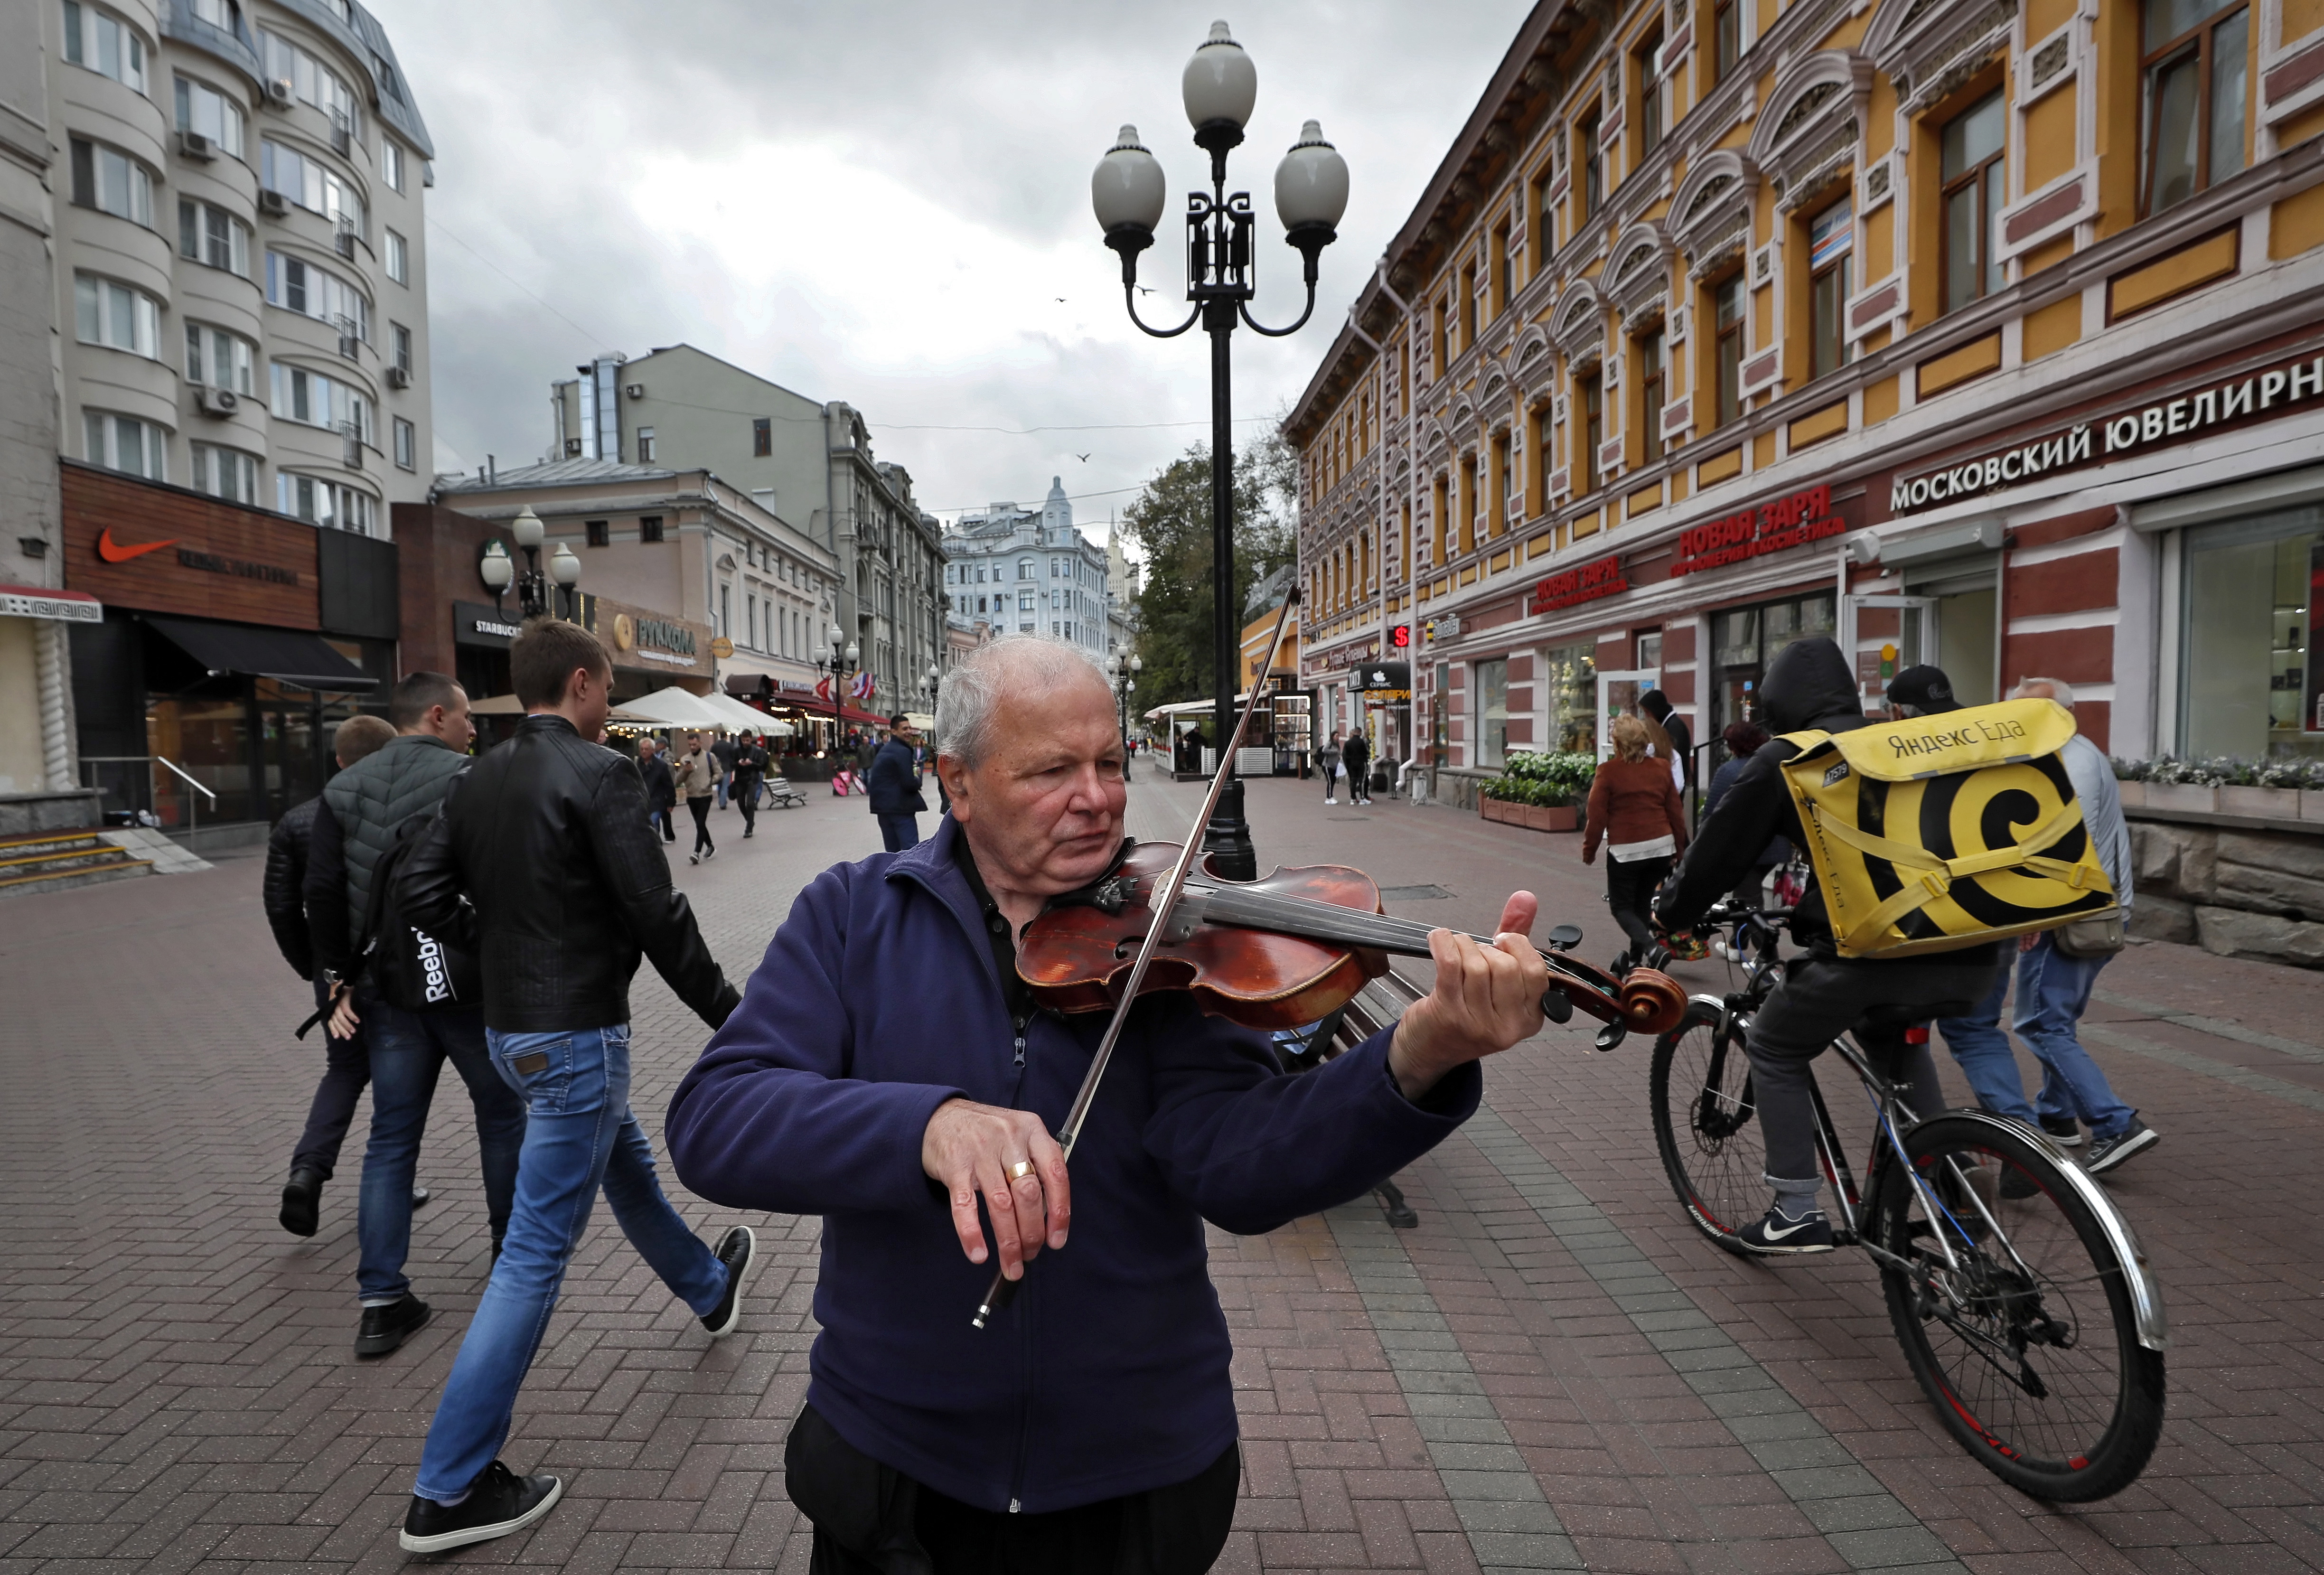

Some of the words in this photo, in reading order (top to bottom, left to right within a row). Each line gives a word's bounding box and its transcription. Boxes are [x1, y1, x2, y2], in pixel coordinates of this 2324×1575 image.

[1890, 424, 2091, 512] МОСКОВСКИЙ
[2105, 356, 2324, 453] ЮВЕЛИРН
[1680, 510, 1755, 557] НОВАЯ
[1760, 484, 1831, 533] ЗАРЯ
[1670, 545, 1745, 577] ПАРФЮМЕРИЯ
[1760, 516, 1846, 551] КОСМЕТИКА
[1537, 569, 1578, 601] НОВАЯ
[1580, 555, 1619, 588] ЗАРЯ
[638, 618, 696, 656] РУККОЛА
[1395, 626, 1409, 647] $
[1888, 728, 1978, 759] Яндекс
[1974, 720, 2027, 741] Еда
[411, 926, 449, 1003] Reebo
[1688, 1205, 1723, 1238] MERIDA
